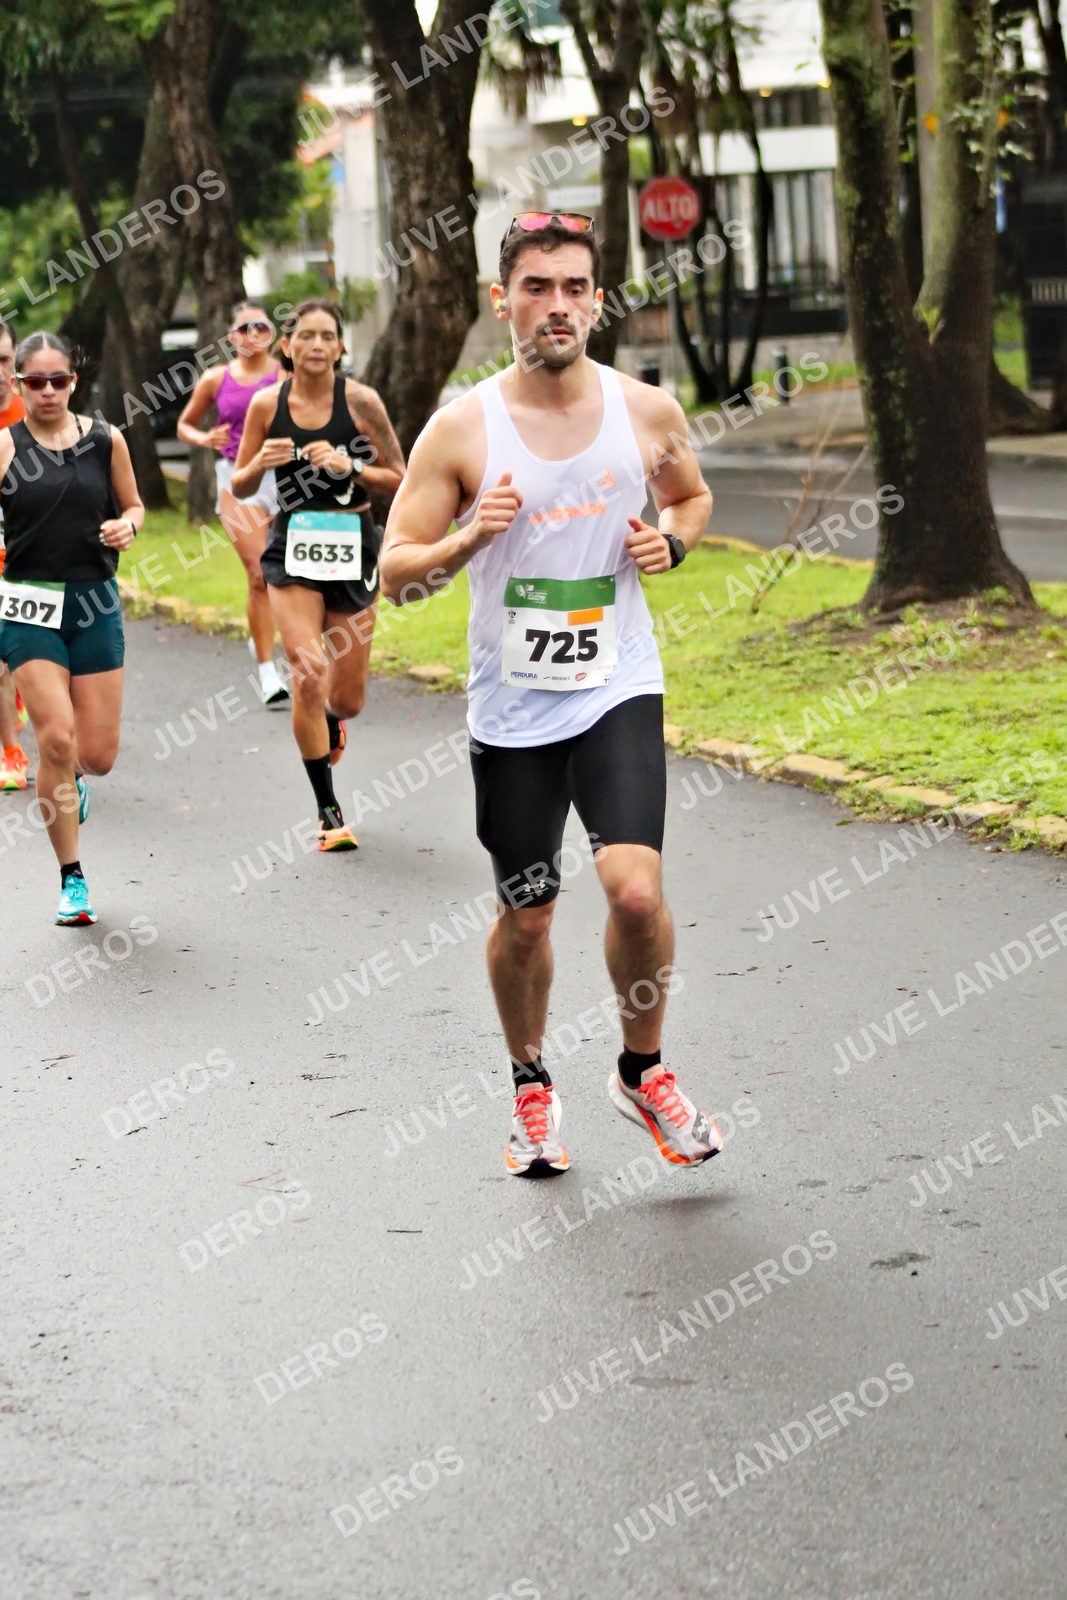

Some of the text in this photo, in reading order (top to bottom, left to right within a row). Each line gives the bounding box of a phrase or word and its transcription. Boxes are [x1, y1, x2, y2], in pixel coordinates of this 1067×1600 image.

[642, 193, 699, 221] ALTO
[293, 543, 354, 563] 6633
[0, 595, 56, 624] 307
[525, 628, 598, 664] 725
